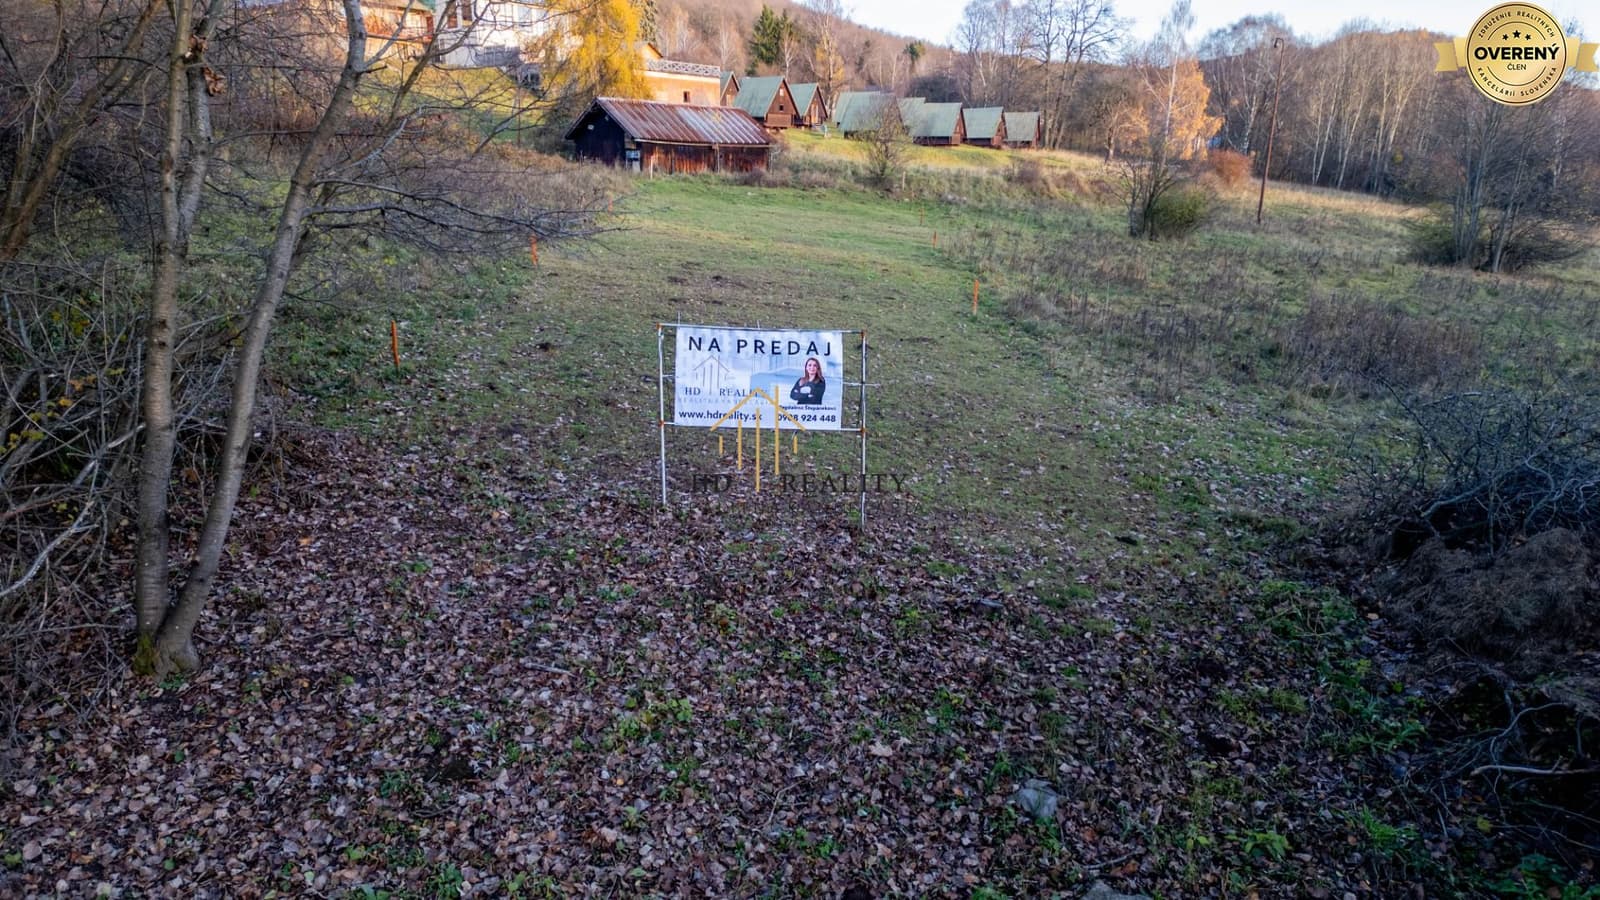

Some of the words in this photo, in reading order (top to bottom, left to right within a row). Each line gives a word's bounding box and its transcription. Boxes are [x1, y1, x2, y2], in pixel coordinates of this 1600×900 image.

[688, 336, 721, 352] NA
[737, 339, 831, 356] PREDAJ
[685, 386, 701, 396] HD
[719, 387, 767, 397] REALI
[801, 414, 818, 422] 924
[820, 414, 836, 422] 448
